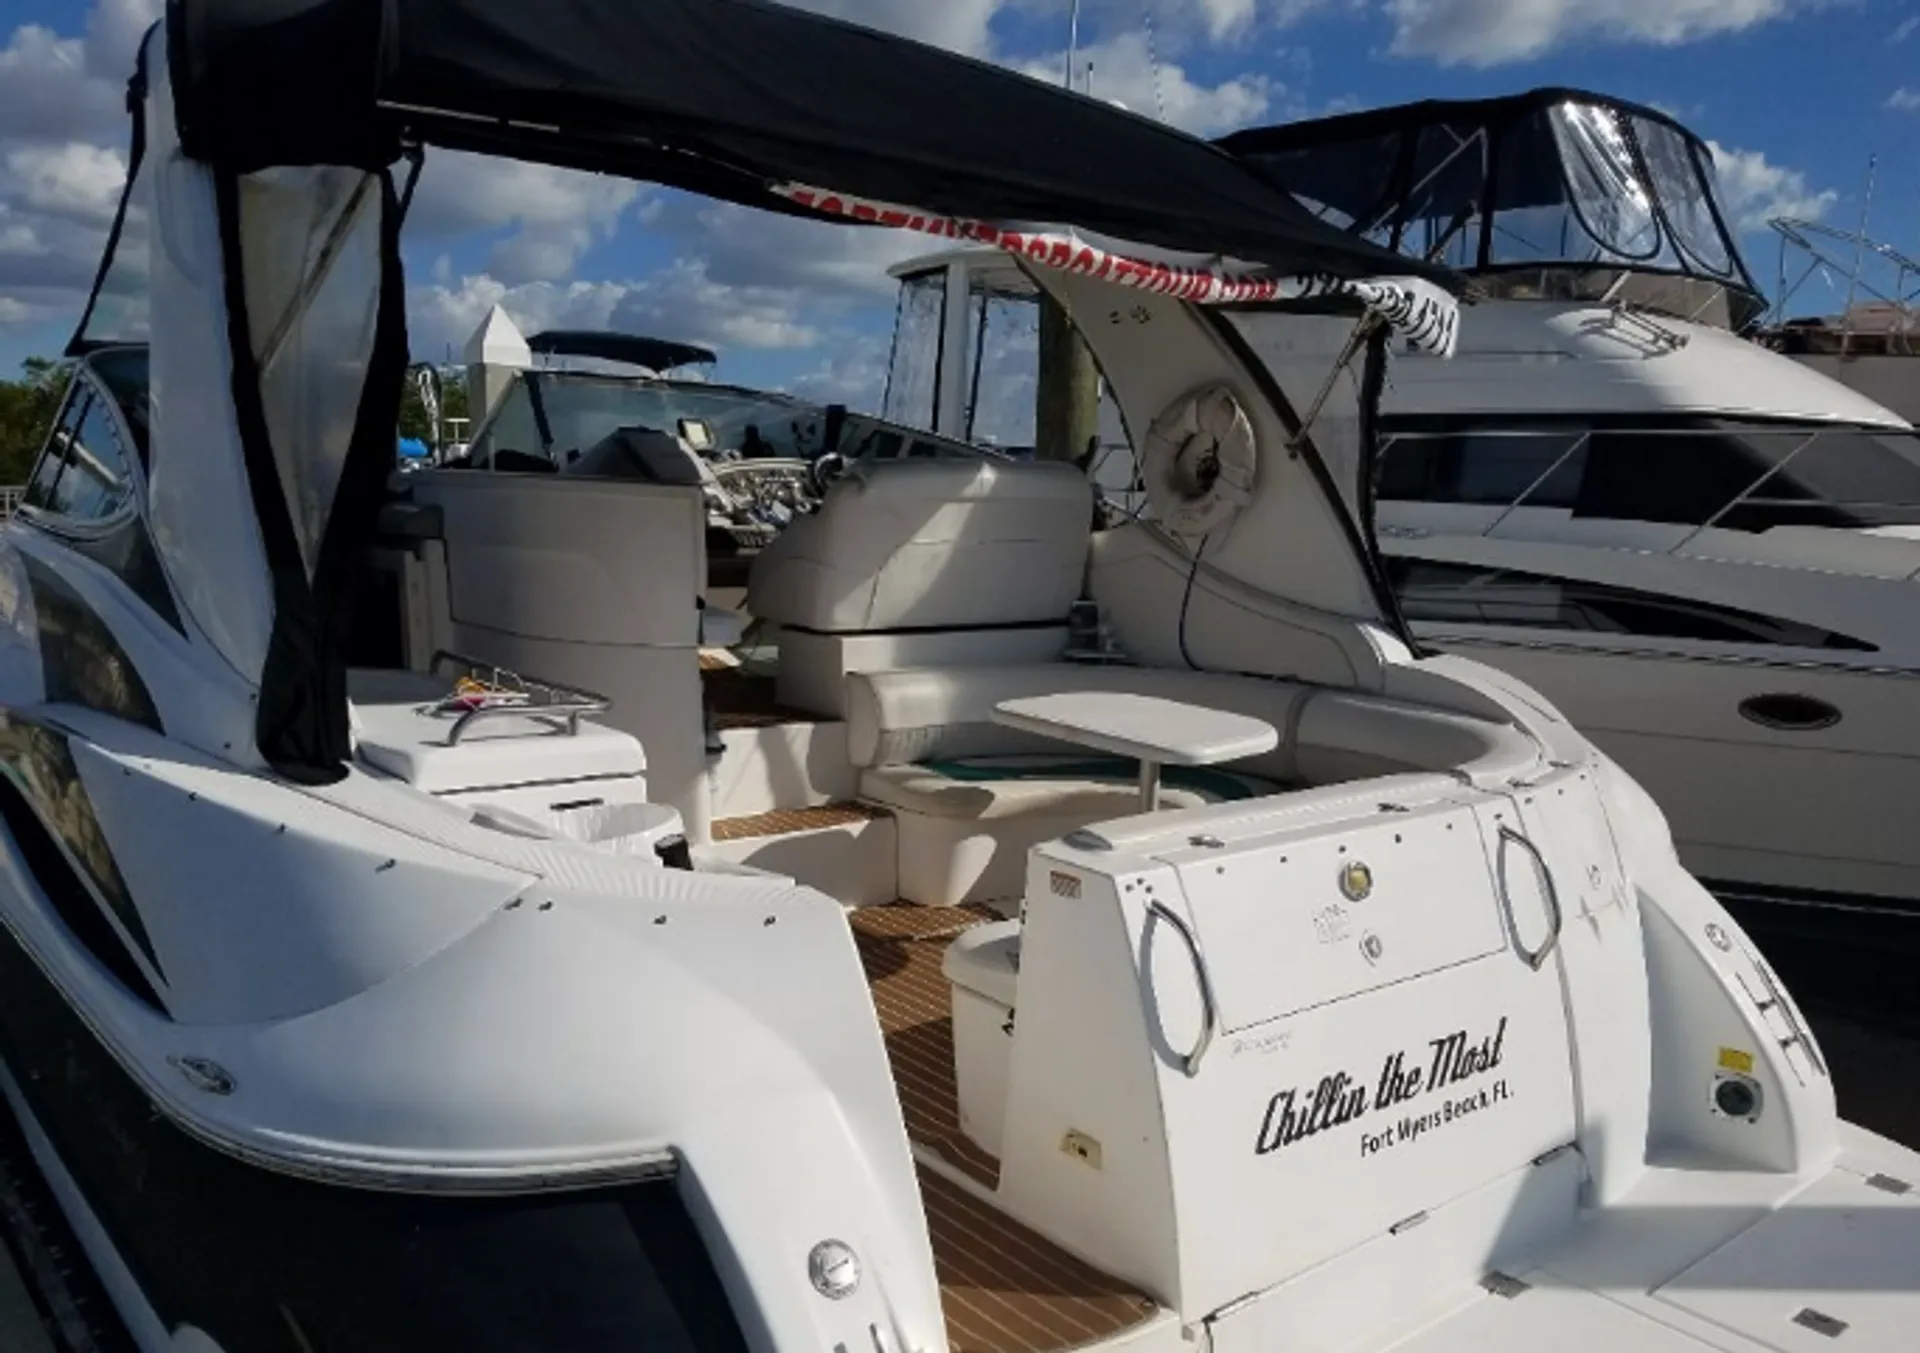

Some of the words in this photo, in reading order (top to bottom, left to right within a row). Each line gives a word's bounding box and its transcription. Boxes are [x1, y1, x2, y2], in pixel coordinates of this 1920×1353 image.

[1254, 1070, 1370, 1155] Chillin
[1374, 1050, 1425, 1112] the
[1426, 1015, 1508, 1092] Most
[1360, 1132, 1394, 1158] Fort
[1397, 1110, 1442, 1142] Myers
